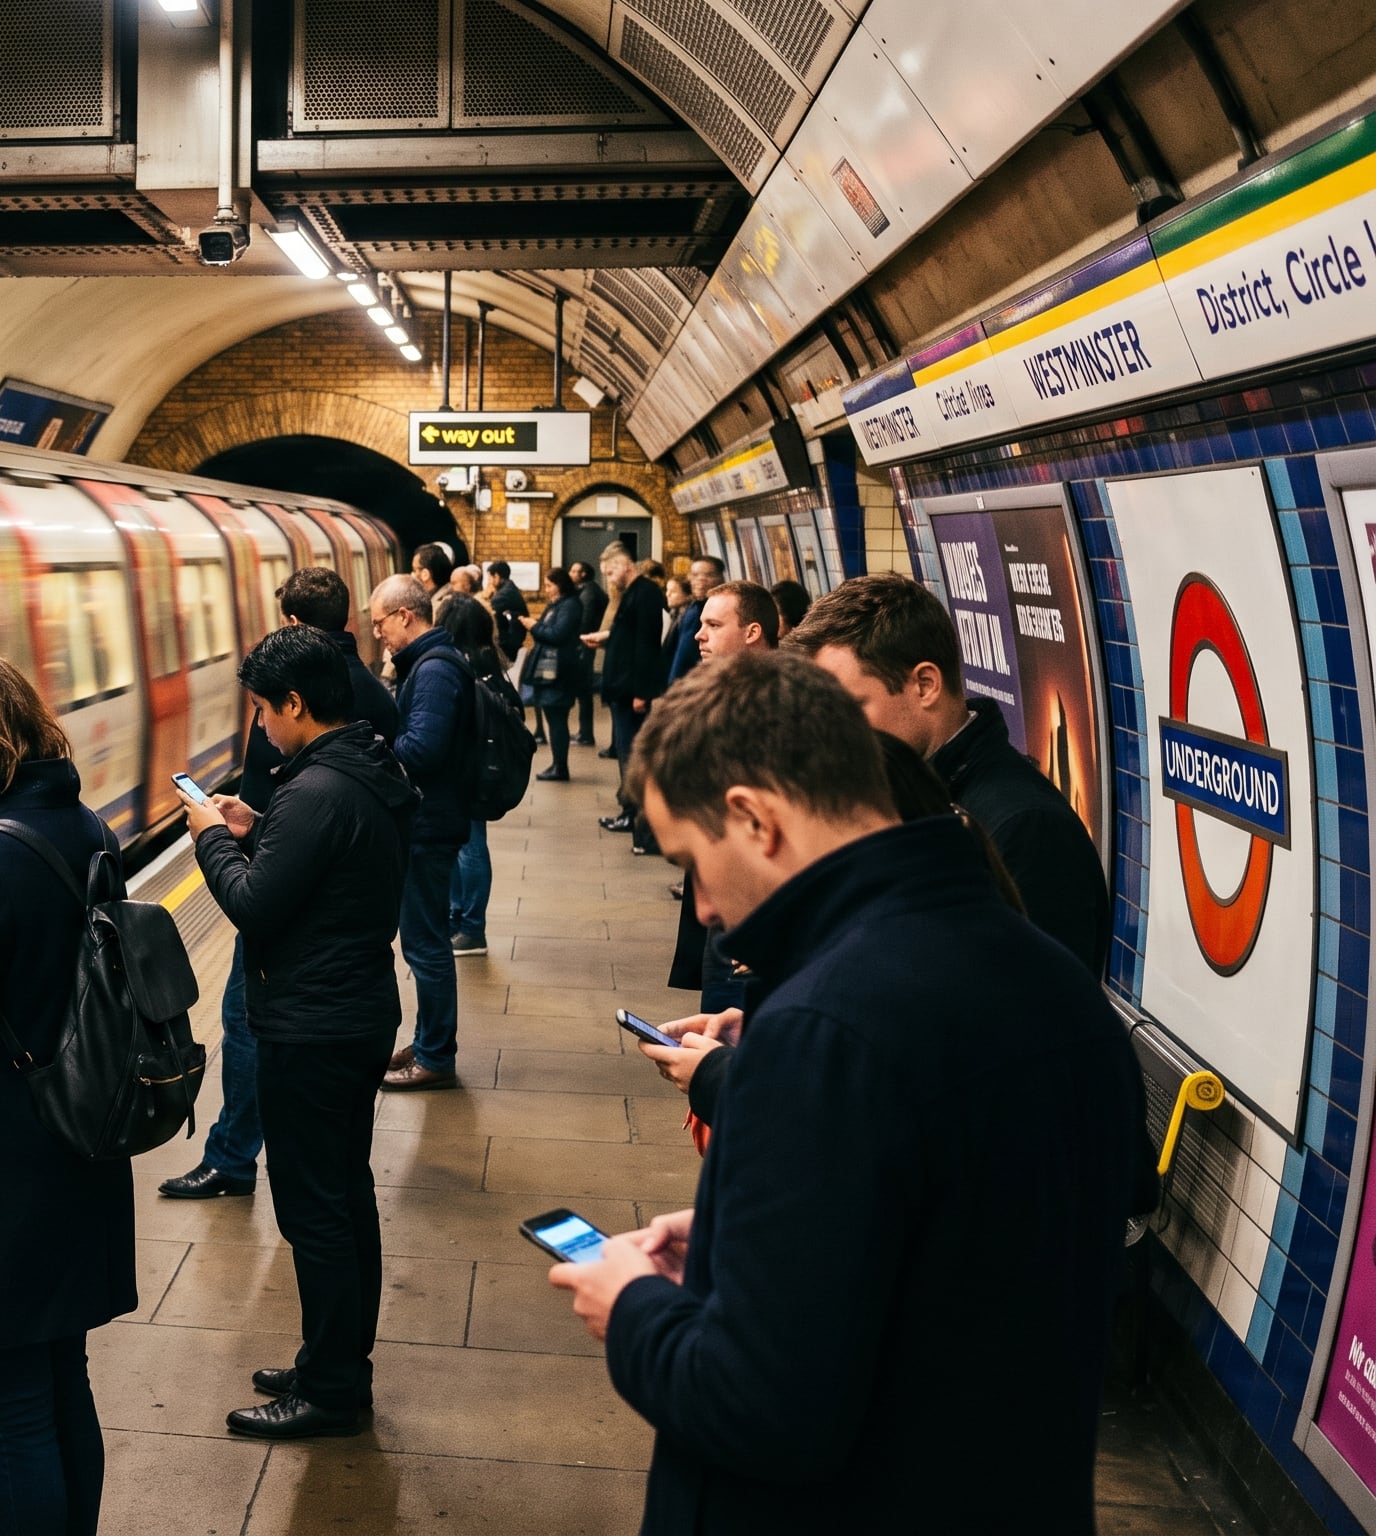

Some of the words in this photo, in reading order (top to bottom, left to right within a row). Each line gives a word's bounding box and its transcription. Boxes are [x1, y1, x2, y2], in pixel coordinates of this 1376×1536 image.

[1196, 268, 1290, 335] District,
[1285, 235, 1367, 305] Circle
[1022, 319, 1153, 401] WESTMINSTER
[441, 429, 480, 449] way
[481, 426, 516, 445] out
[1165, 738, 1280, 816] UNDERGROUND
